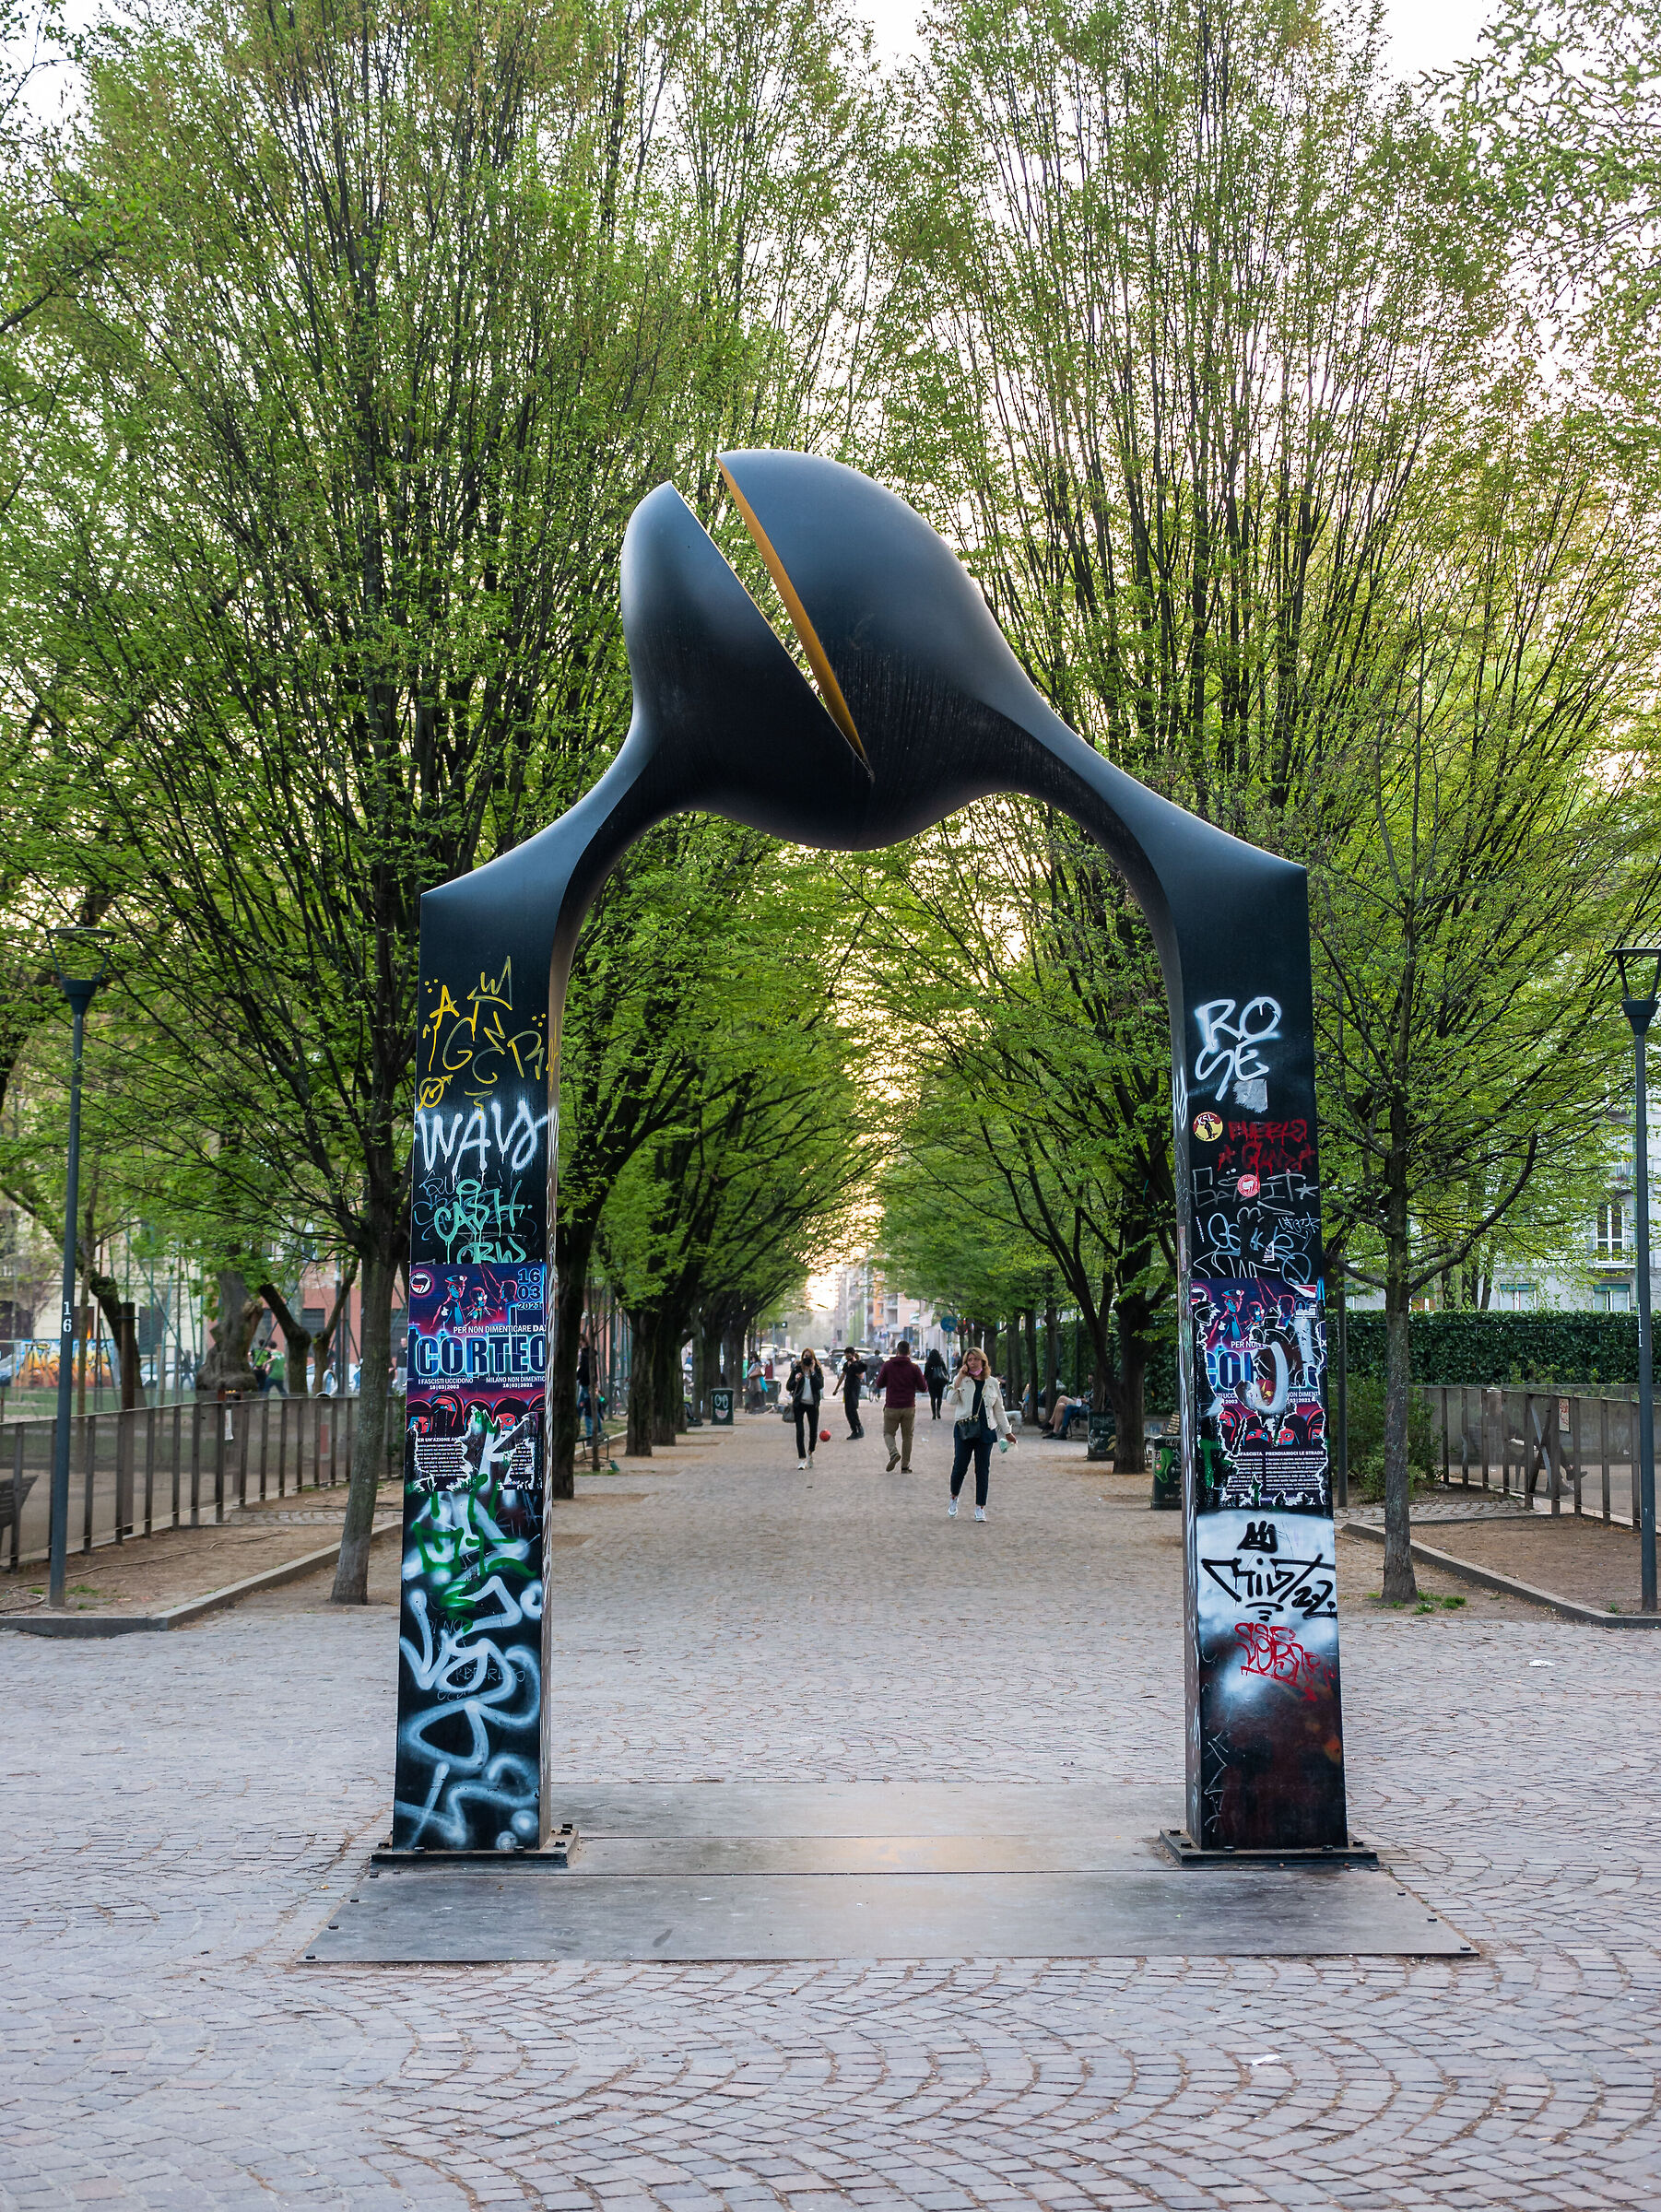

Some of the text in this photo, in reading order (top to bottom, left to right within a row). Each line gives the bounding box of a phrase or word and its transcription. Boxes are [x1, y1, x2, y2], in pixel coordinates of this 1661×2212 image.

[1197, 1114, 1215, 1125] KSL
[517, 1268, 541, 1284] 16
[517, 1286, 541, 1300] 03
